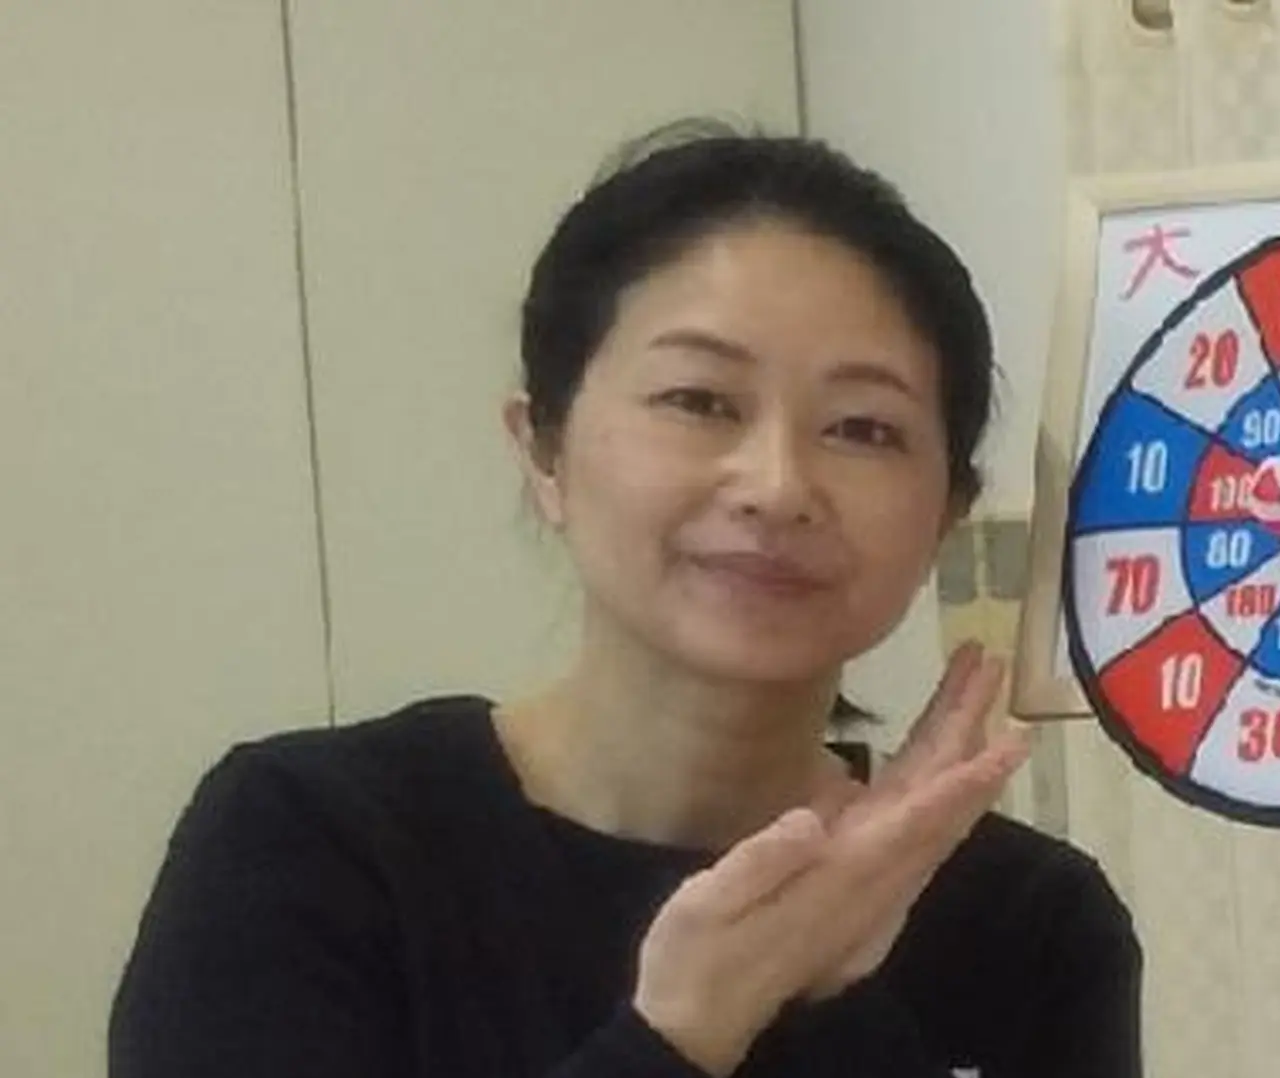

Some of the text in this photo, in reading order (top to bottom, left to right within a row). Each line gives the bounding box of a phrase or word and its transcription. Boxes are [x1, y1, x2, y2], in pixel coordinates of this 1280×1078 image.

[1124, 223, 1199, 299] 大
[1186, 330, 1238, 389] 20
[1243, 410, 1280, 447] 90
[1128, 444, 1166, 492] 10
[1107, 556, 1158, 614] 70
[1161, 656, 1202, 709] 10
